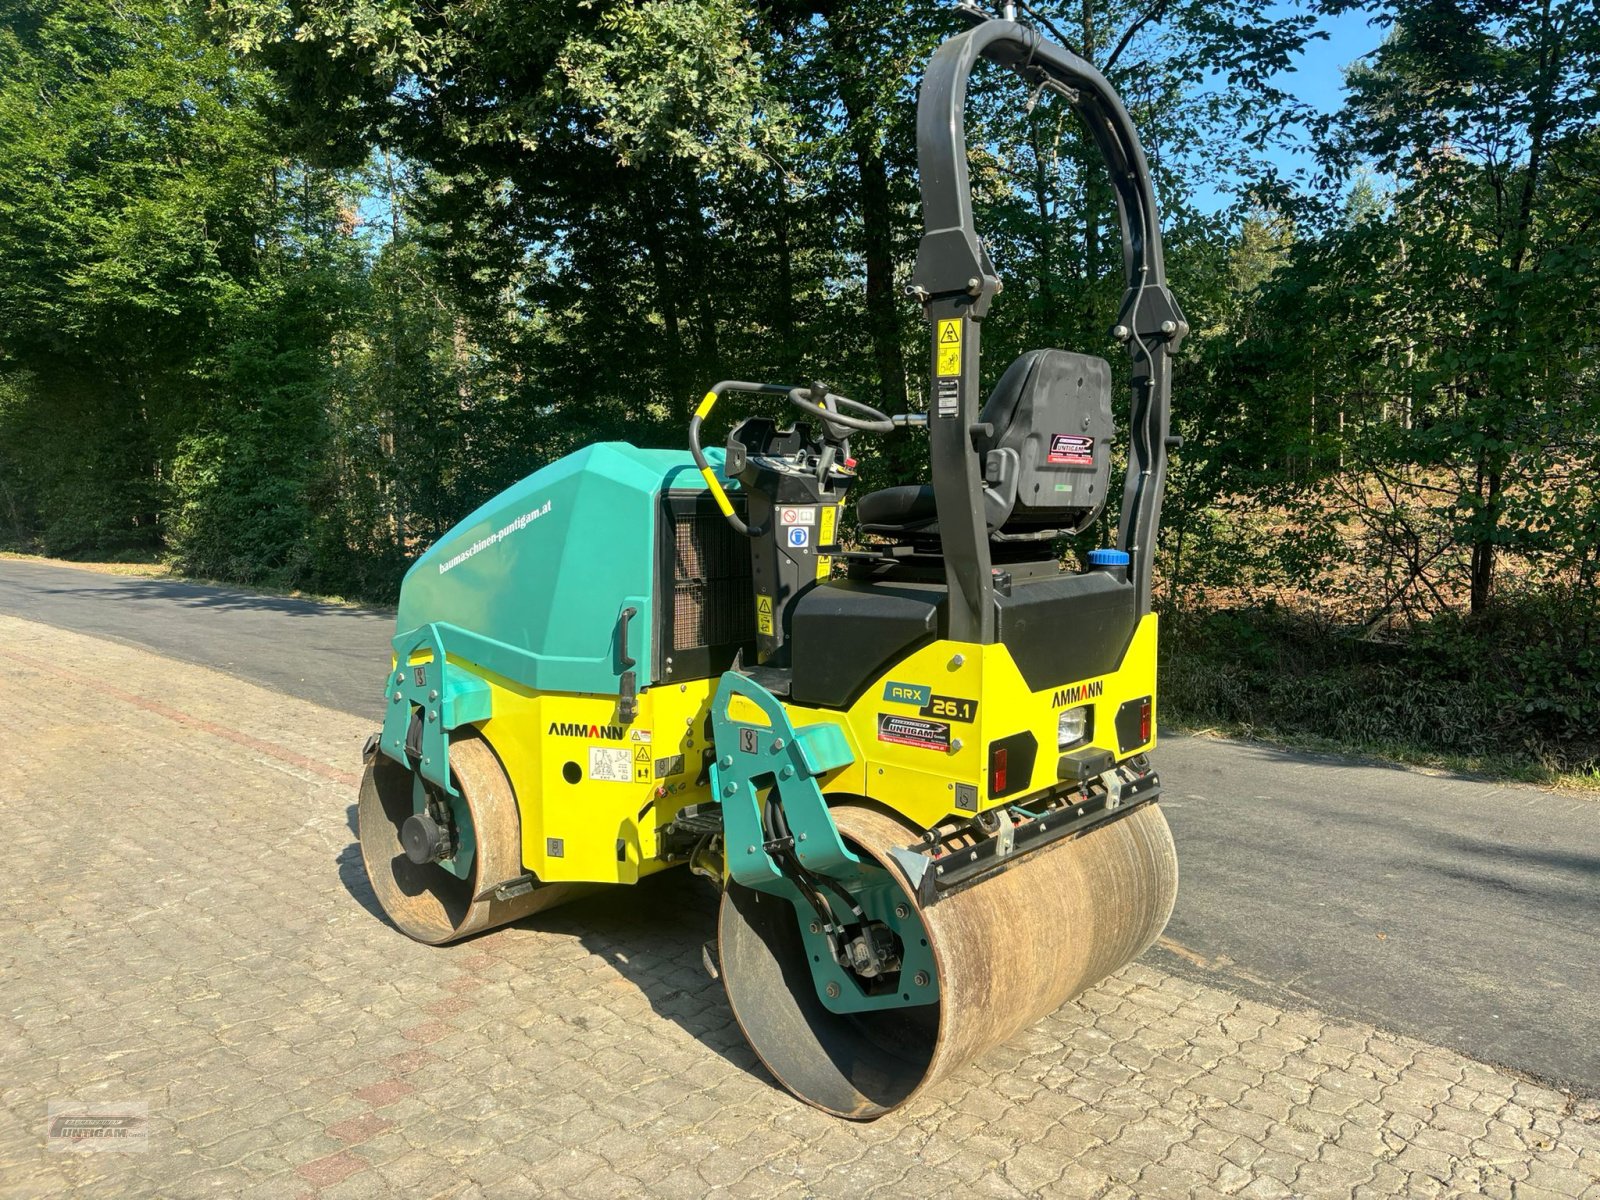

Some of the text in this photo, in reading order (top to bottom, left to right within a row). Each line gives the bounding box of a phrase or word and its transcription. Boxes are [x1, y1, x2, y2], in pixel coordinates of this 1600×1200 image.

[439, 500, 552, 575] baumaschinen-puntigam.at
[892, 687, 970, 719] ARX 26.1
[1052, 680, 1103, 708] AMMANN
[548, 722, 623, 740] AMMANN
